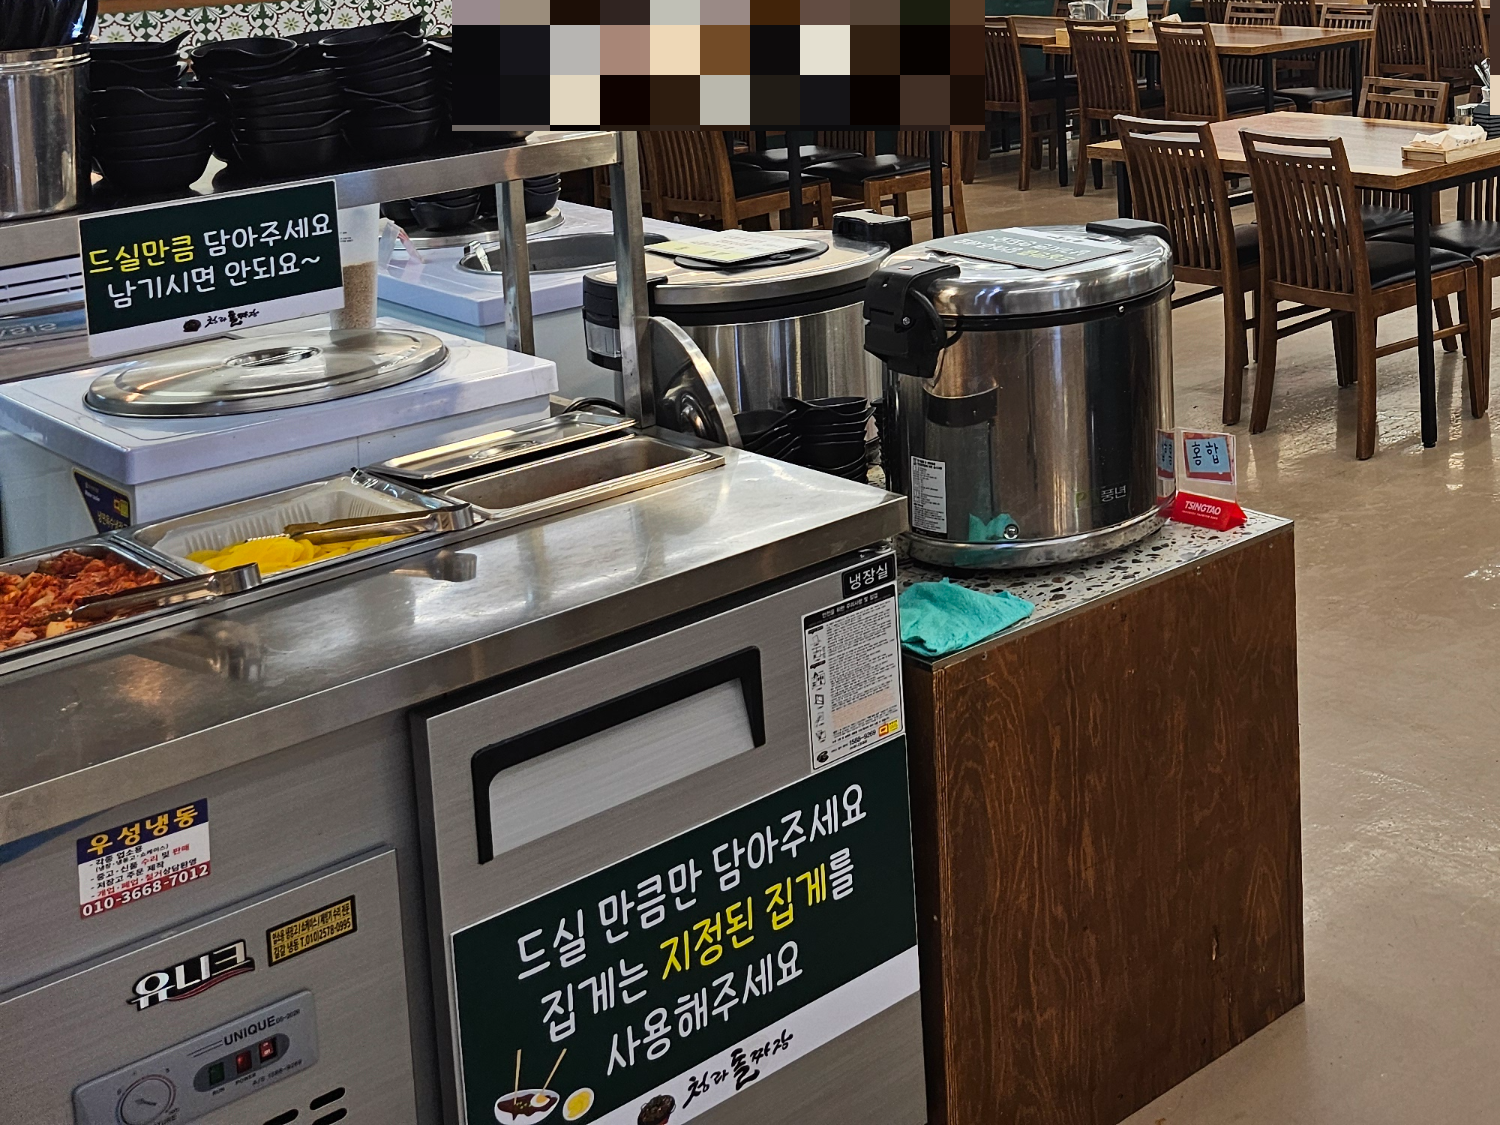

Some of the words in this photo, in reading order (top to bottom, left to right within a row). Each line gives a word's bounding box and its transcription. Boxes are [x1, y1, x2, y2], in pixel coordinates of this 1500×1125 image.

[89, 235, 195, 274] 드실만큼
[204, 213, 333, 257] 담아주세요
[108, 266, 216, 309] 남기시면
[225, 252, 321, 288] 안되요~
[1101, 485, 1127, 503] 풍년
[1184, 500, 1222, 515] TSINGTAO
[849, 562, 889, 591] 냉장실
[87, 805, 198, 855] 우성냉동
[141, 855, 158, 866] 수리
[517, 908, 586, 980] 드실
[599, 859, 702, 944] 만큼만
[712, 784, 867, 892] 담아주세요
[82, 864, 209, 917] 010-3668-7012
[541, 959, 648, 1043] 집게는
[659, 896, 753, 980] 지정된
[765, 848, 855, 931] 집게를
[131, 941, 246, 1010] 유니크
[223, 1015, 277, 1046] UNIQUE
[607, 941, 803, 1076] 사용해주세요
[682, 1029, 793, 1109] 청라돌짜장
